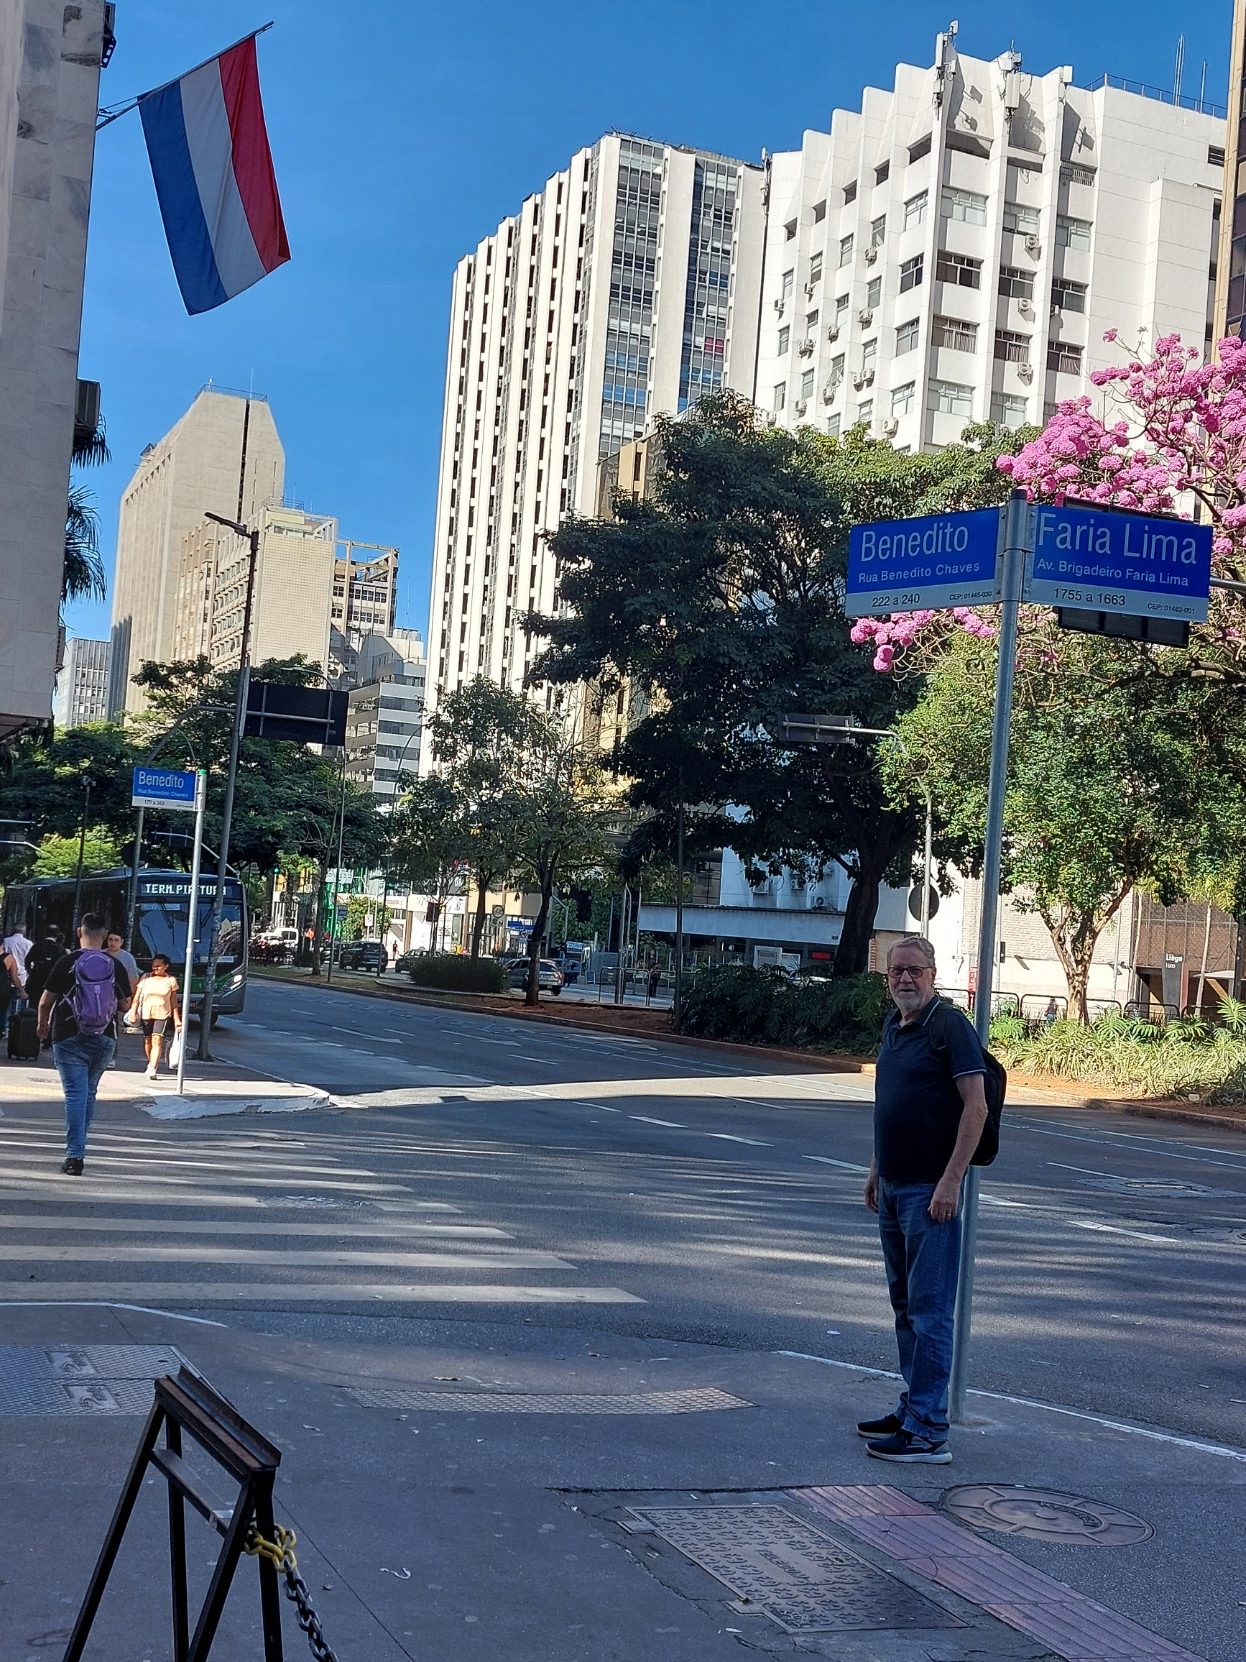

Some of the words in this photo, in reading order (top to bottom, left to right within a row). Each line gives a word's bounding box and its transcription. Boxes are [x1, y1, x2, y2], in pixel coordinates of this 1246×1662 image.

[861, 522, 969, 562] Benedito
[1038, 512, 1111, 555] Faria
[1123, 522, 1197, 565] Lima
[858, 572, 878, 583] Rua
[881, 566, 932, 581] Benedito
[935, 561, 980, 576] Chaves
[1037, 558, 1054, 571] Av.
[1059, 560, 1122, 579] Brigadeiro
[1125, 568, 1156, 583] Faria
[1159, 572, 1189, 587] Lima
[872, 595, 890, 608] 222
[893, 597, 899, 605] a
[901, 593, 920, 605] 240
[1054, 587, 1082, 601] 1755
[1085, 593, 1093, 602] a
[1099, 593, 1126, 606] 1663
[138, 770, 184, 788] Benedito
